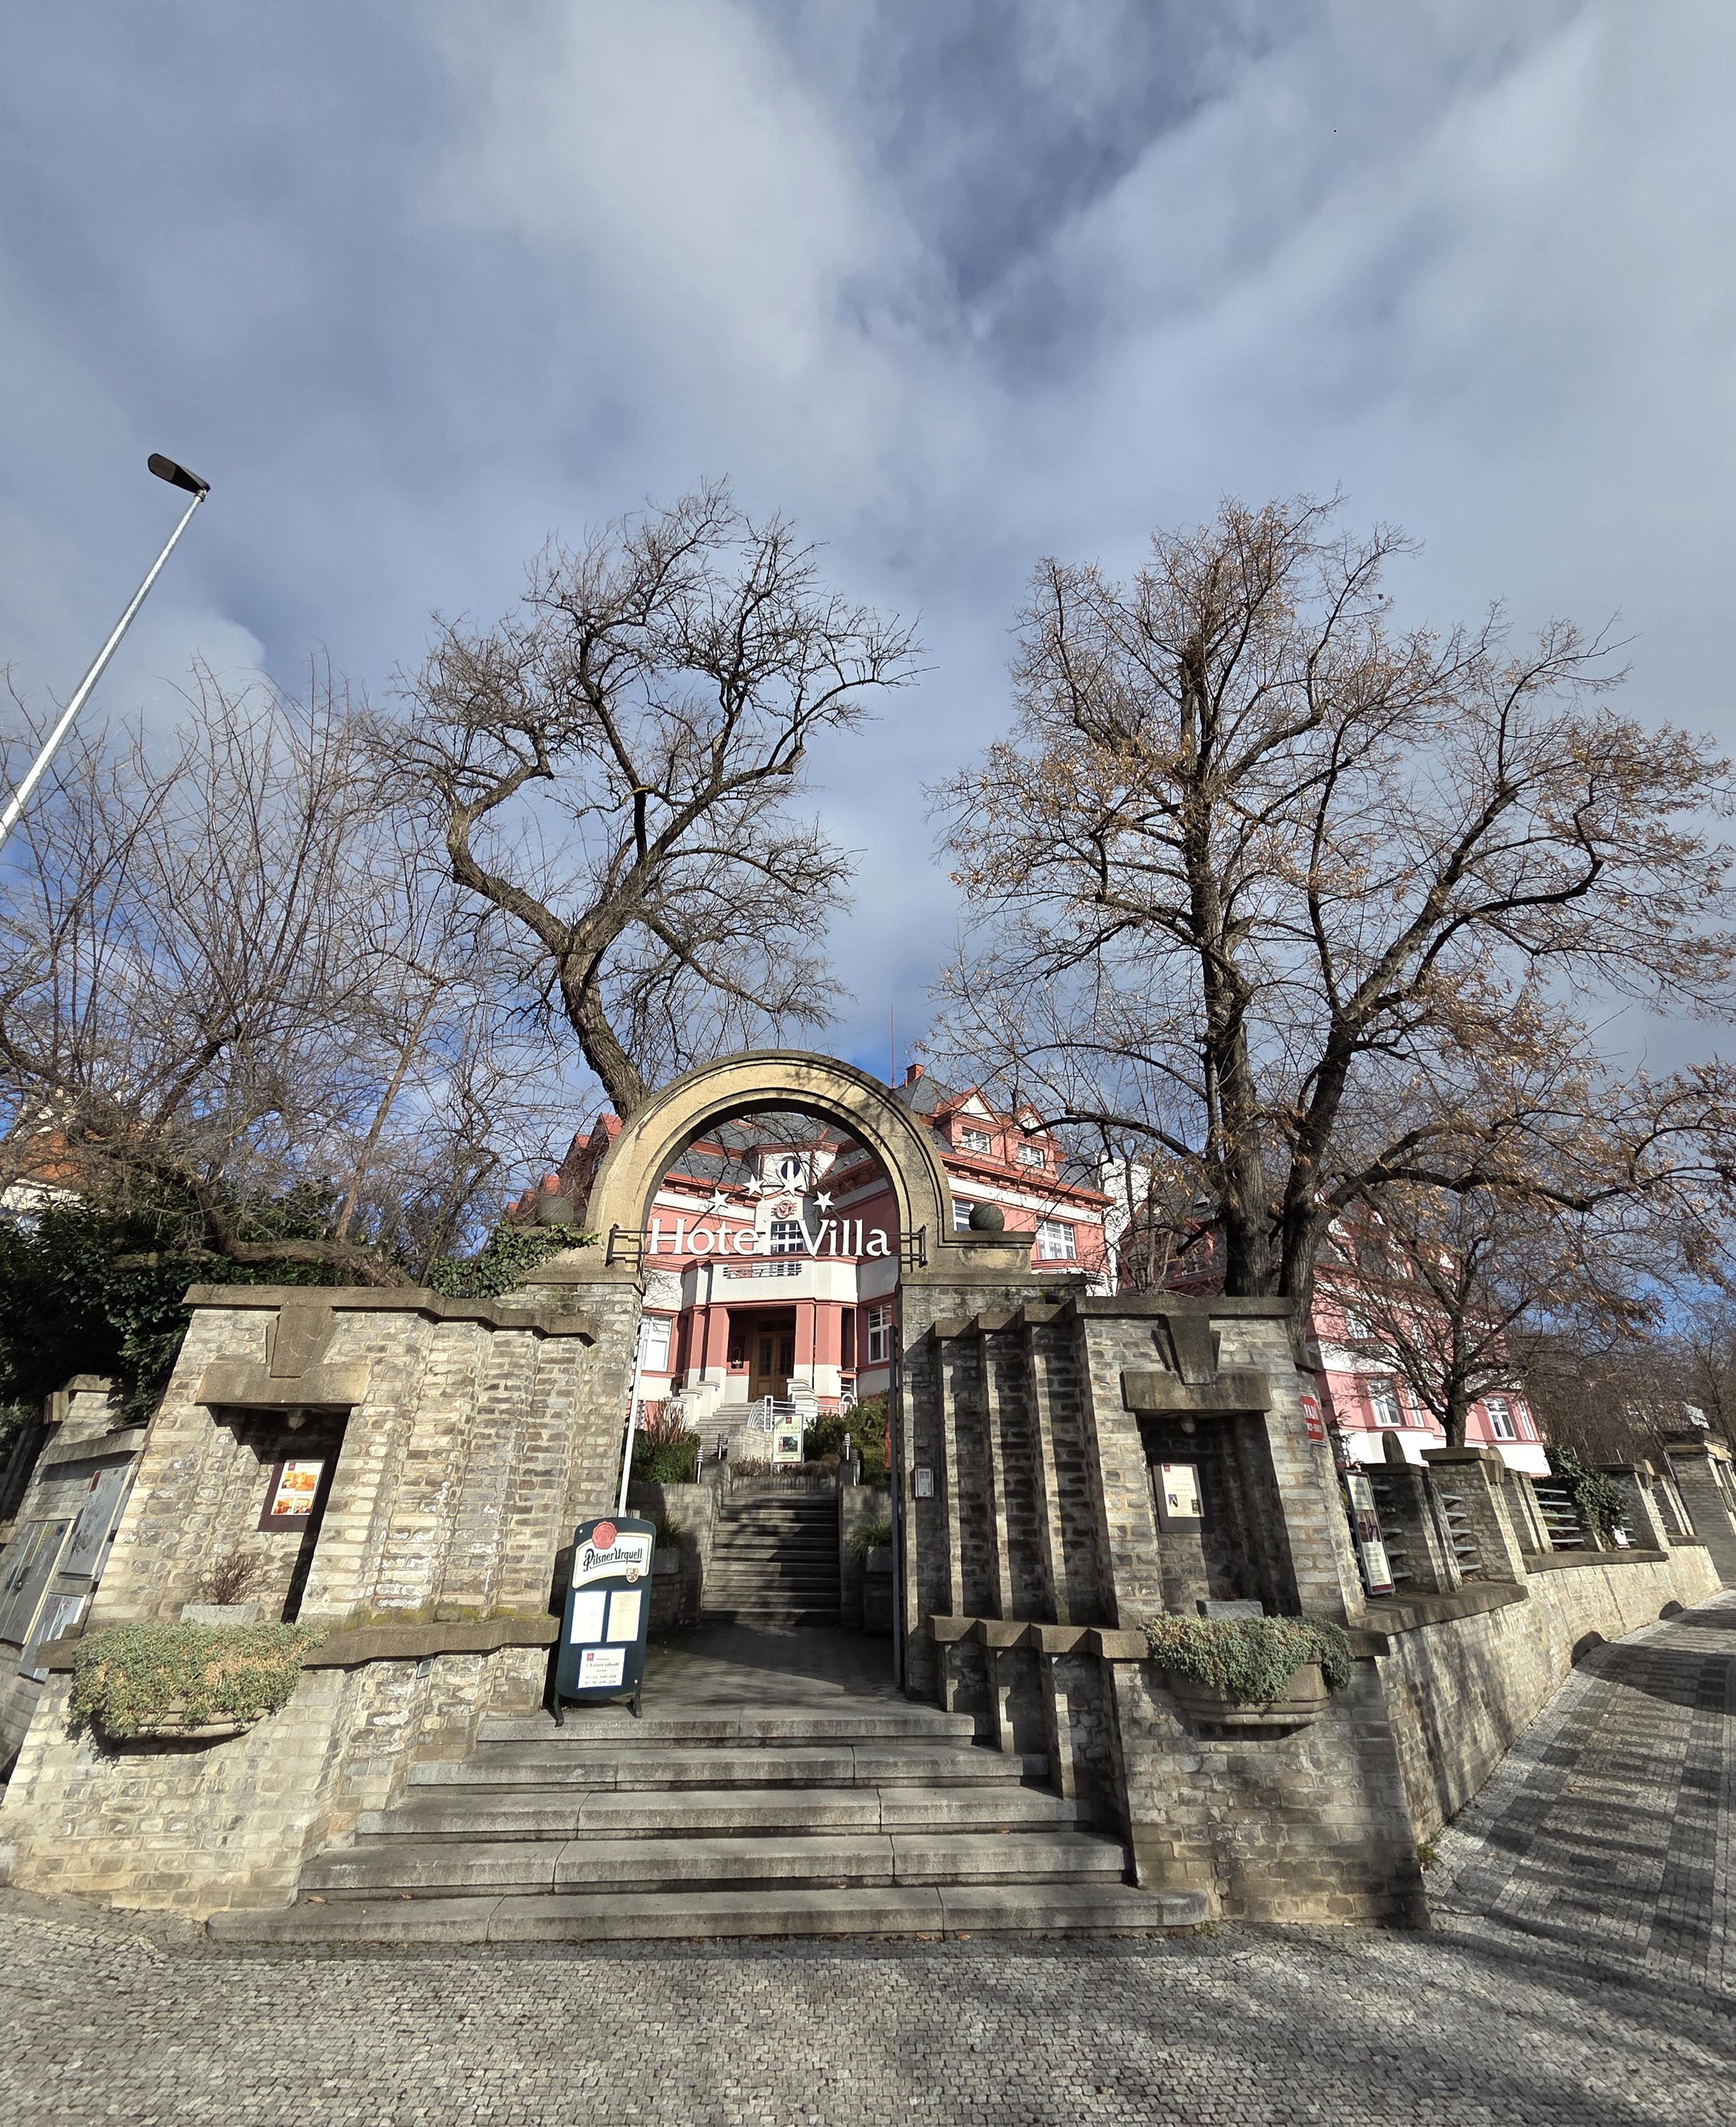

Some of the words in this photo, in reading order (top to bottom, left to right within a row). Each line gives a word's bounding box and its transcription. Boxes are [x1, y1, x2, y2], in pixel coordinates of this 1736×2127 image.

[648, 1217, 773, 1256] Hotel
[797, 1217, 892, 1257] Villa
[583, 1548, 615, 1572] Pilsner
[614, 1547, 643, 1564] Urquell
